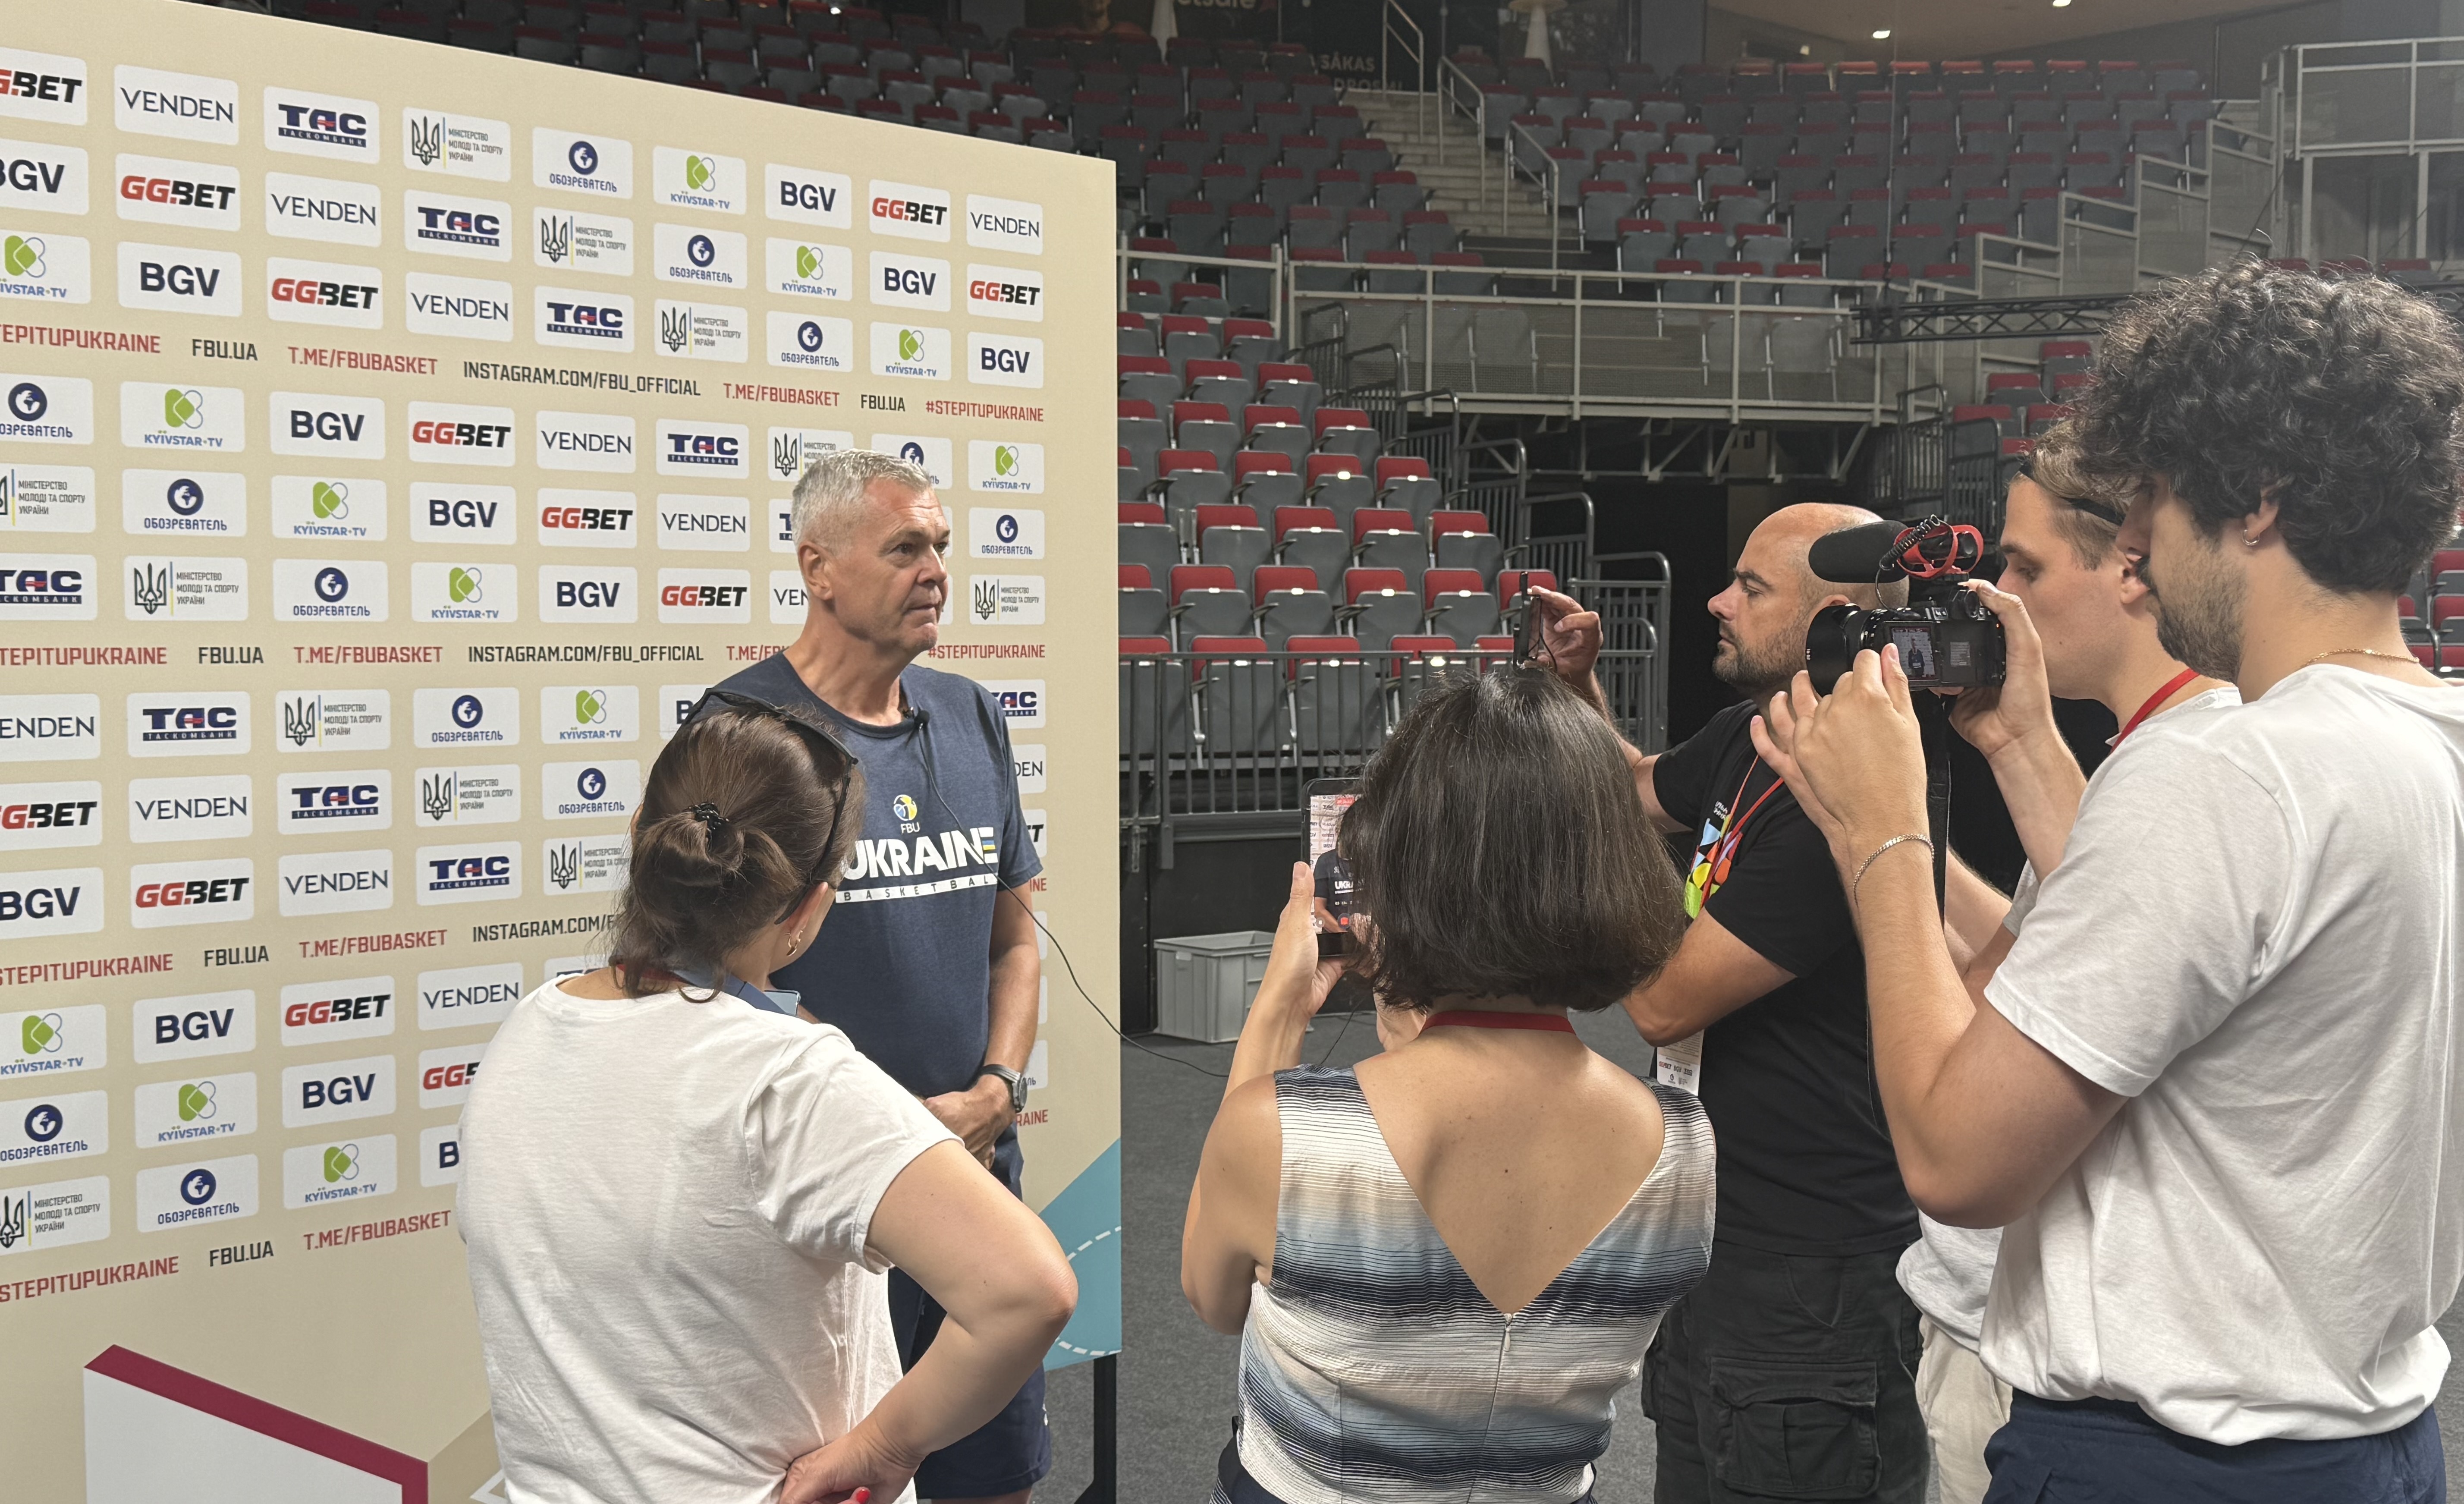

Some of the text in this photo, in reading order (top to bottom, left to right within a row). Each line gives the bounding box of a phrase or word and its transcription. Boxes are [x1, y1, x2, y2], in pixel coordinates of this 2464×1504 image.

[0, 69, 82, 103] .BET
[120, 88, 233, 123] VENDEN
[0, 159, 65, 193] GV
[550, 173, 617, 192] ОБОЗРЕВАТЕЛЬ
[121, 176, 236, 210] GG.BET
[781, 181, 836, 211] BGV
[271, 194, 376, 226] VENDEN
[872, 198, 947, 225] GG.BET
[970, 212, 1039, 237] VENDEN
[141, 262, 220, 297] BGV
[670, 267, 732, 283] ОБОЗРЕВАТЕЛЬ
[884, 267, 936, 296] BGV
[271, 278, 378, 309] GG.BET
[970, 280, 1040, 305] GG.BET
[411, 293, 508, 321] VENDEN
[0, 324, 160, 353] EPITUPUKRAINE
[192, 339, 258, 361] FBU.UA
[288, 346, 437, 374] T.ME/FBUBASKET
[781, 352, 839, 366] ОБОЗРЕВАТЕЛЬ
[981, 347, 1030, 373] BGV
[464, 362, 701, 396] INSTAGRAM.COM/FBU_OFFICIAL
[723, 383, 839, 406] T.ME/FBUBASKET
[861, 394, 905, 412] FBU.UA
[926, 400, 1043, 422] #STEPITUPUKRAINE
[0, 423, 73, 438] ОЗРЕВАТЕЛЬ
[291, 410, 365, 441] BGV
[413, 421, 511, 447] GG.BET
[541, 431, 631, 453] VENDEN
[144, 518, 227, 530] ОБОЗРЕВАТЕЛЬ
[430, 500, 497, 528] BGV
[542, 507, 633, 530] GG.BET
[662, 513, 745, 533] VENDEN
[982, 545, 1032, 555] ОБОЗРЕВАТЕЛЬ
[0, 570, 82, 592] АС
[4, 595, 78, 603] СКОМБАНК
[557, 582, 620, 607] BGV
[662, 586, 747, 606] GG.BET
[293, 605, 370, 616] ОБОЗРЕВАТЕЛЬ
[0, 647, 167, 665] TEPITUPUKRAINE
[199, 647, 264, 664] FBU.UA
[294, 646, 443, 664] T.ME/FBUBASKET
[469, 645, 704, 663] INSTAGRAM.COM/FBU_OFFICIAL
[928, 644, 1045, 659] #STEPITUPUKRAINE
[993, 692, 1037, 708] АС
[0, 717, 94, 738] ENDEN
[432, 730, 503, 742] ОБОЗРЕВАТЕЛЬ
[0, 801, 97, 829] G.BET
[135, 796, 247, 820] VENDEN
[559, 801, 625, 814] ОБОЗРЕВАТЕЛЬ
[900, 822, 920, 835] FBU
[844, 827, 998, 880] UKRAINE
[136, 878, 249, 908] GG.BET
[285, 870, 388, 894] VENDEN
[844, 879, 989, 901] BASKETBAL
[0, 887, 80, 921] BGV
[474, 913, 614, 942] INSTAGRAM.COM/F
[204, 946, 269, 966] FBU.UA
[299, 929, 447, 958] T.ME/FBUBASKET
[0, 953, 173, 985] TEPITUPUKRAINE
[424, 982, 519, 1009] VENDEN
[286, 994, 390, 1026] GG.BET
[156, 1009, 234, 1044] BGV
[303, 1073, 376, 1109] BGV
[0, 1140, 88, 1161] ОБОЗРЕВАТЕЛЬ
[158, 1202, 239, 1224] ОБОЗРЕВАТЕЛЬ
[304, 1210, 451, 1250] T.ME/FBUBASKET
[210, 1241, 273, 1267] FBU.UA
[0, 1256, 179, 1303] STEPITUPUKRAINE
